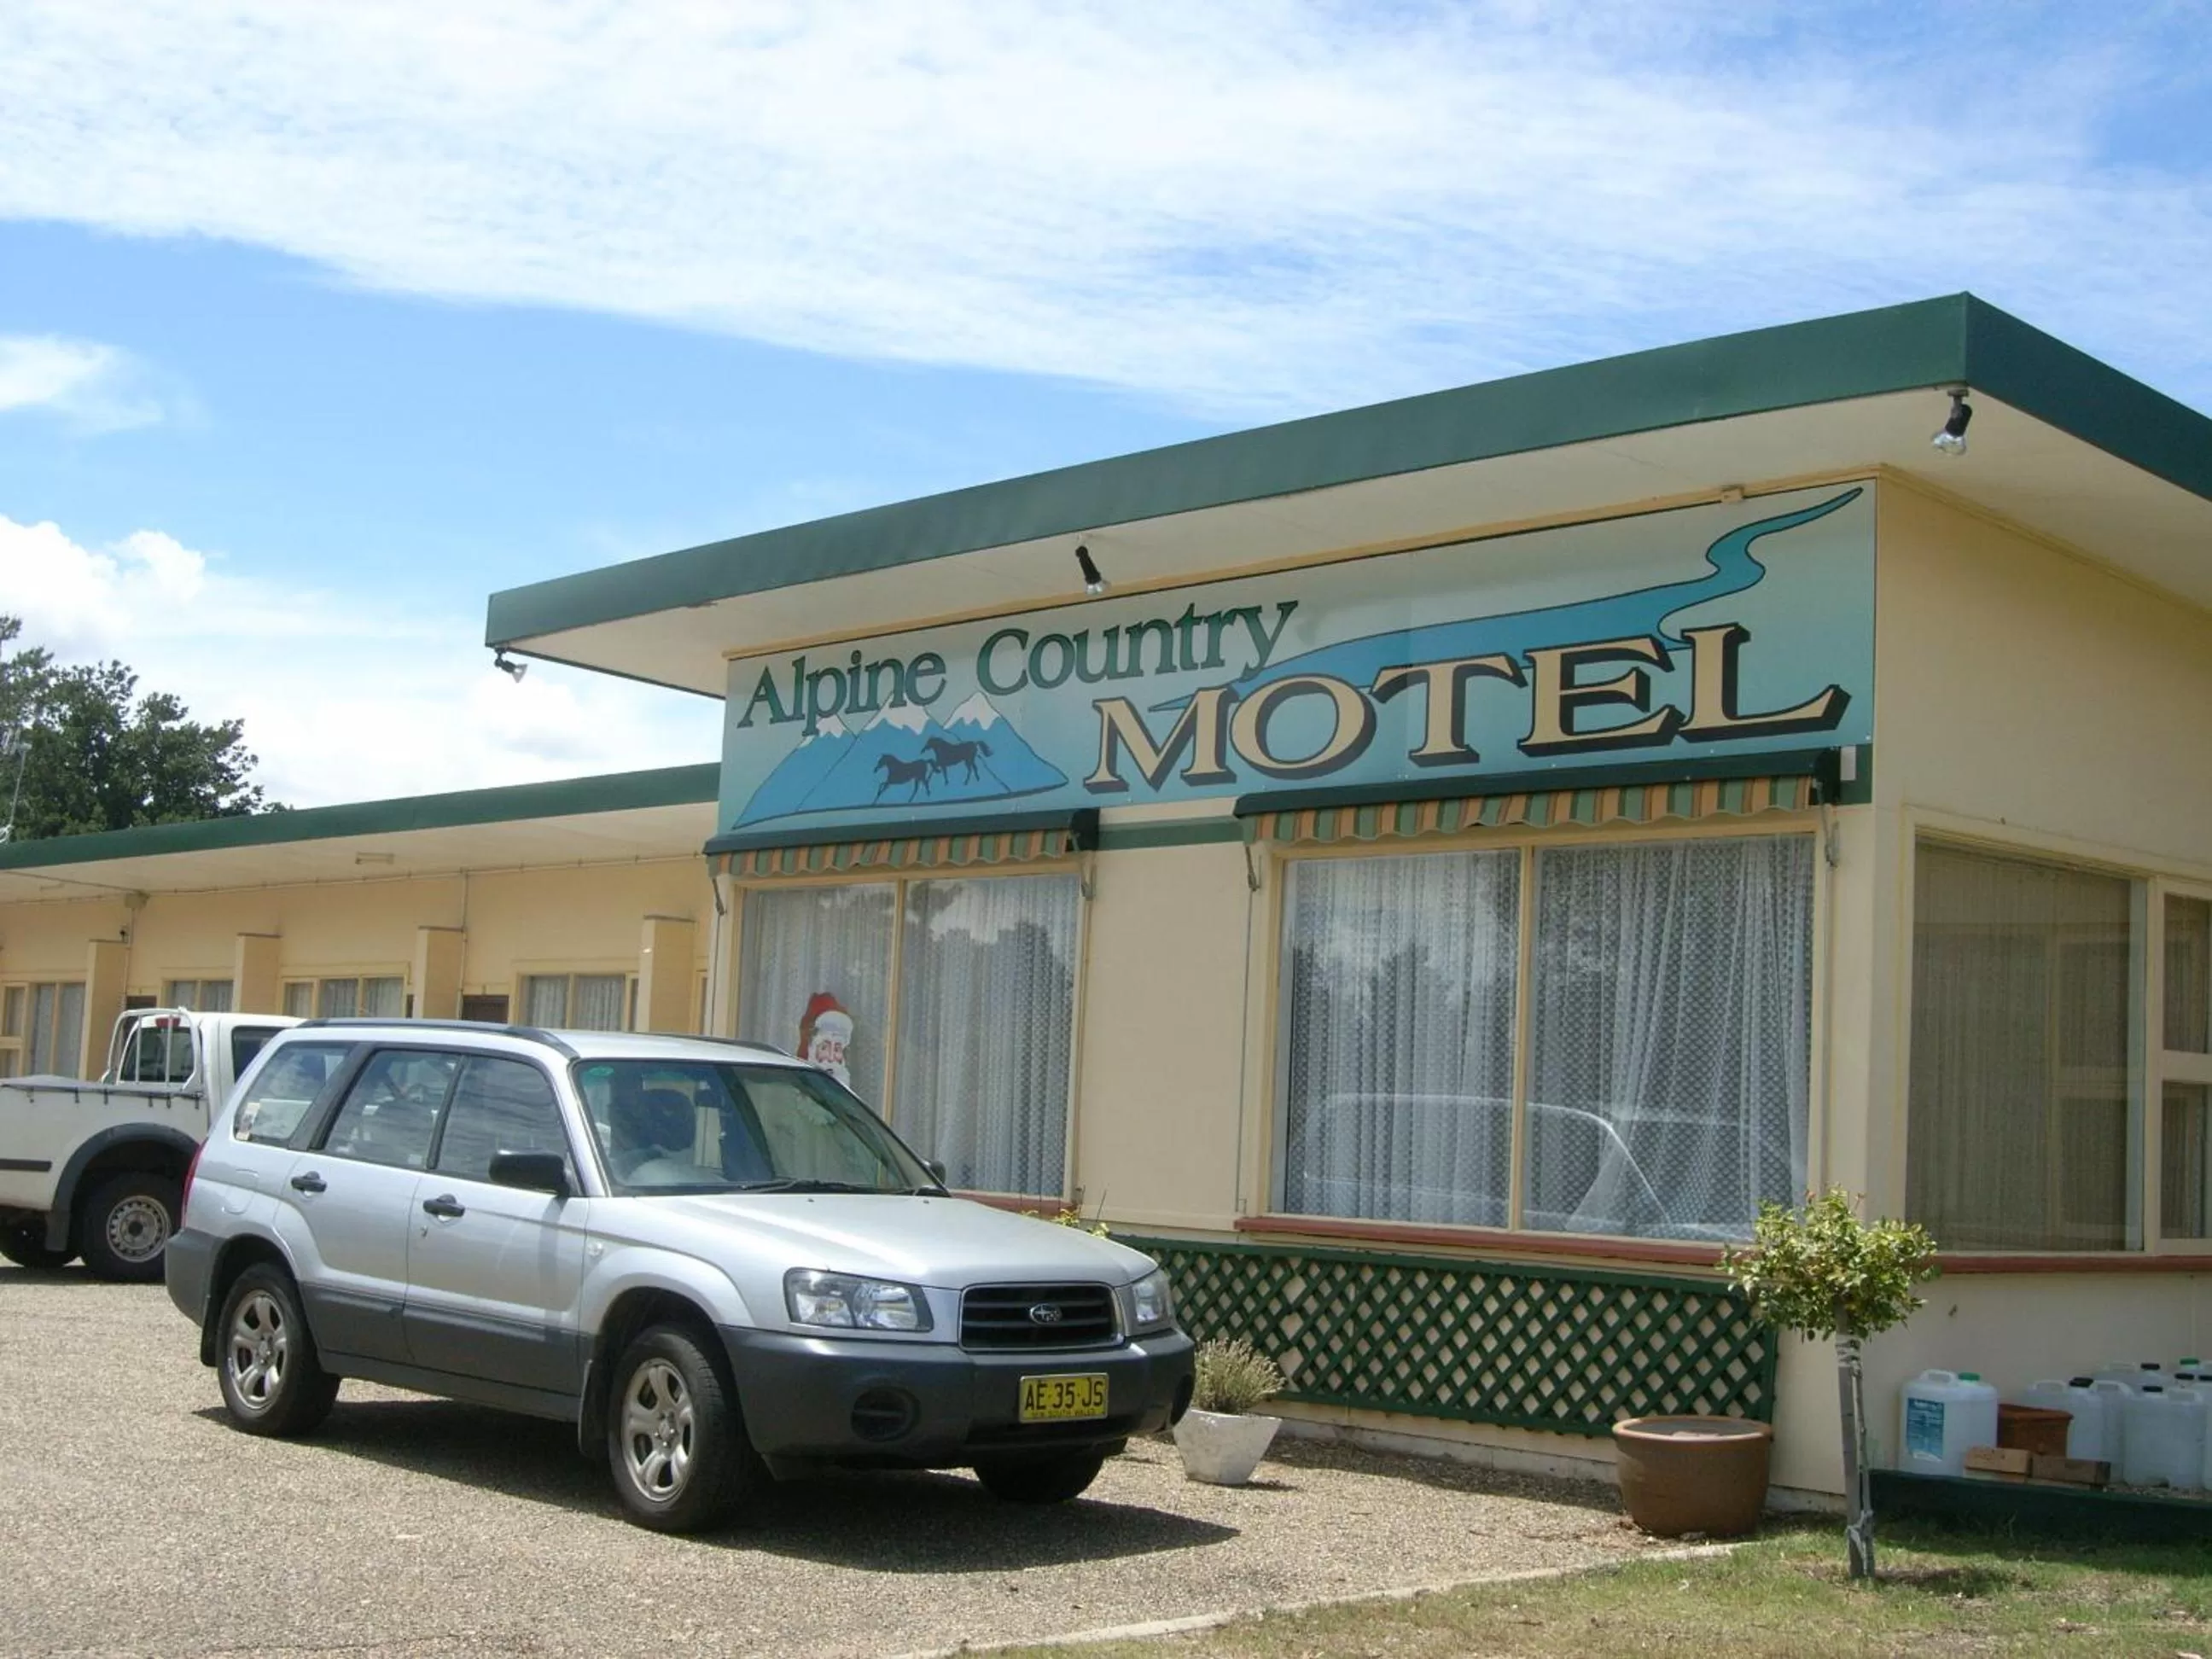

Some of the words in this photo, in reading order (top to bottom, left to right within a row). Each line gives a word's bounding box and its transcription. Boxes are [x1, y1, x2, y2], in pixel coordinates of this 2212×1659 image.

[738, 649, 946, 736] Alpine
[977, 600, 1299, 696] Country
[1083, 623, 1852, 793] MOTEL
